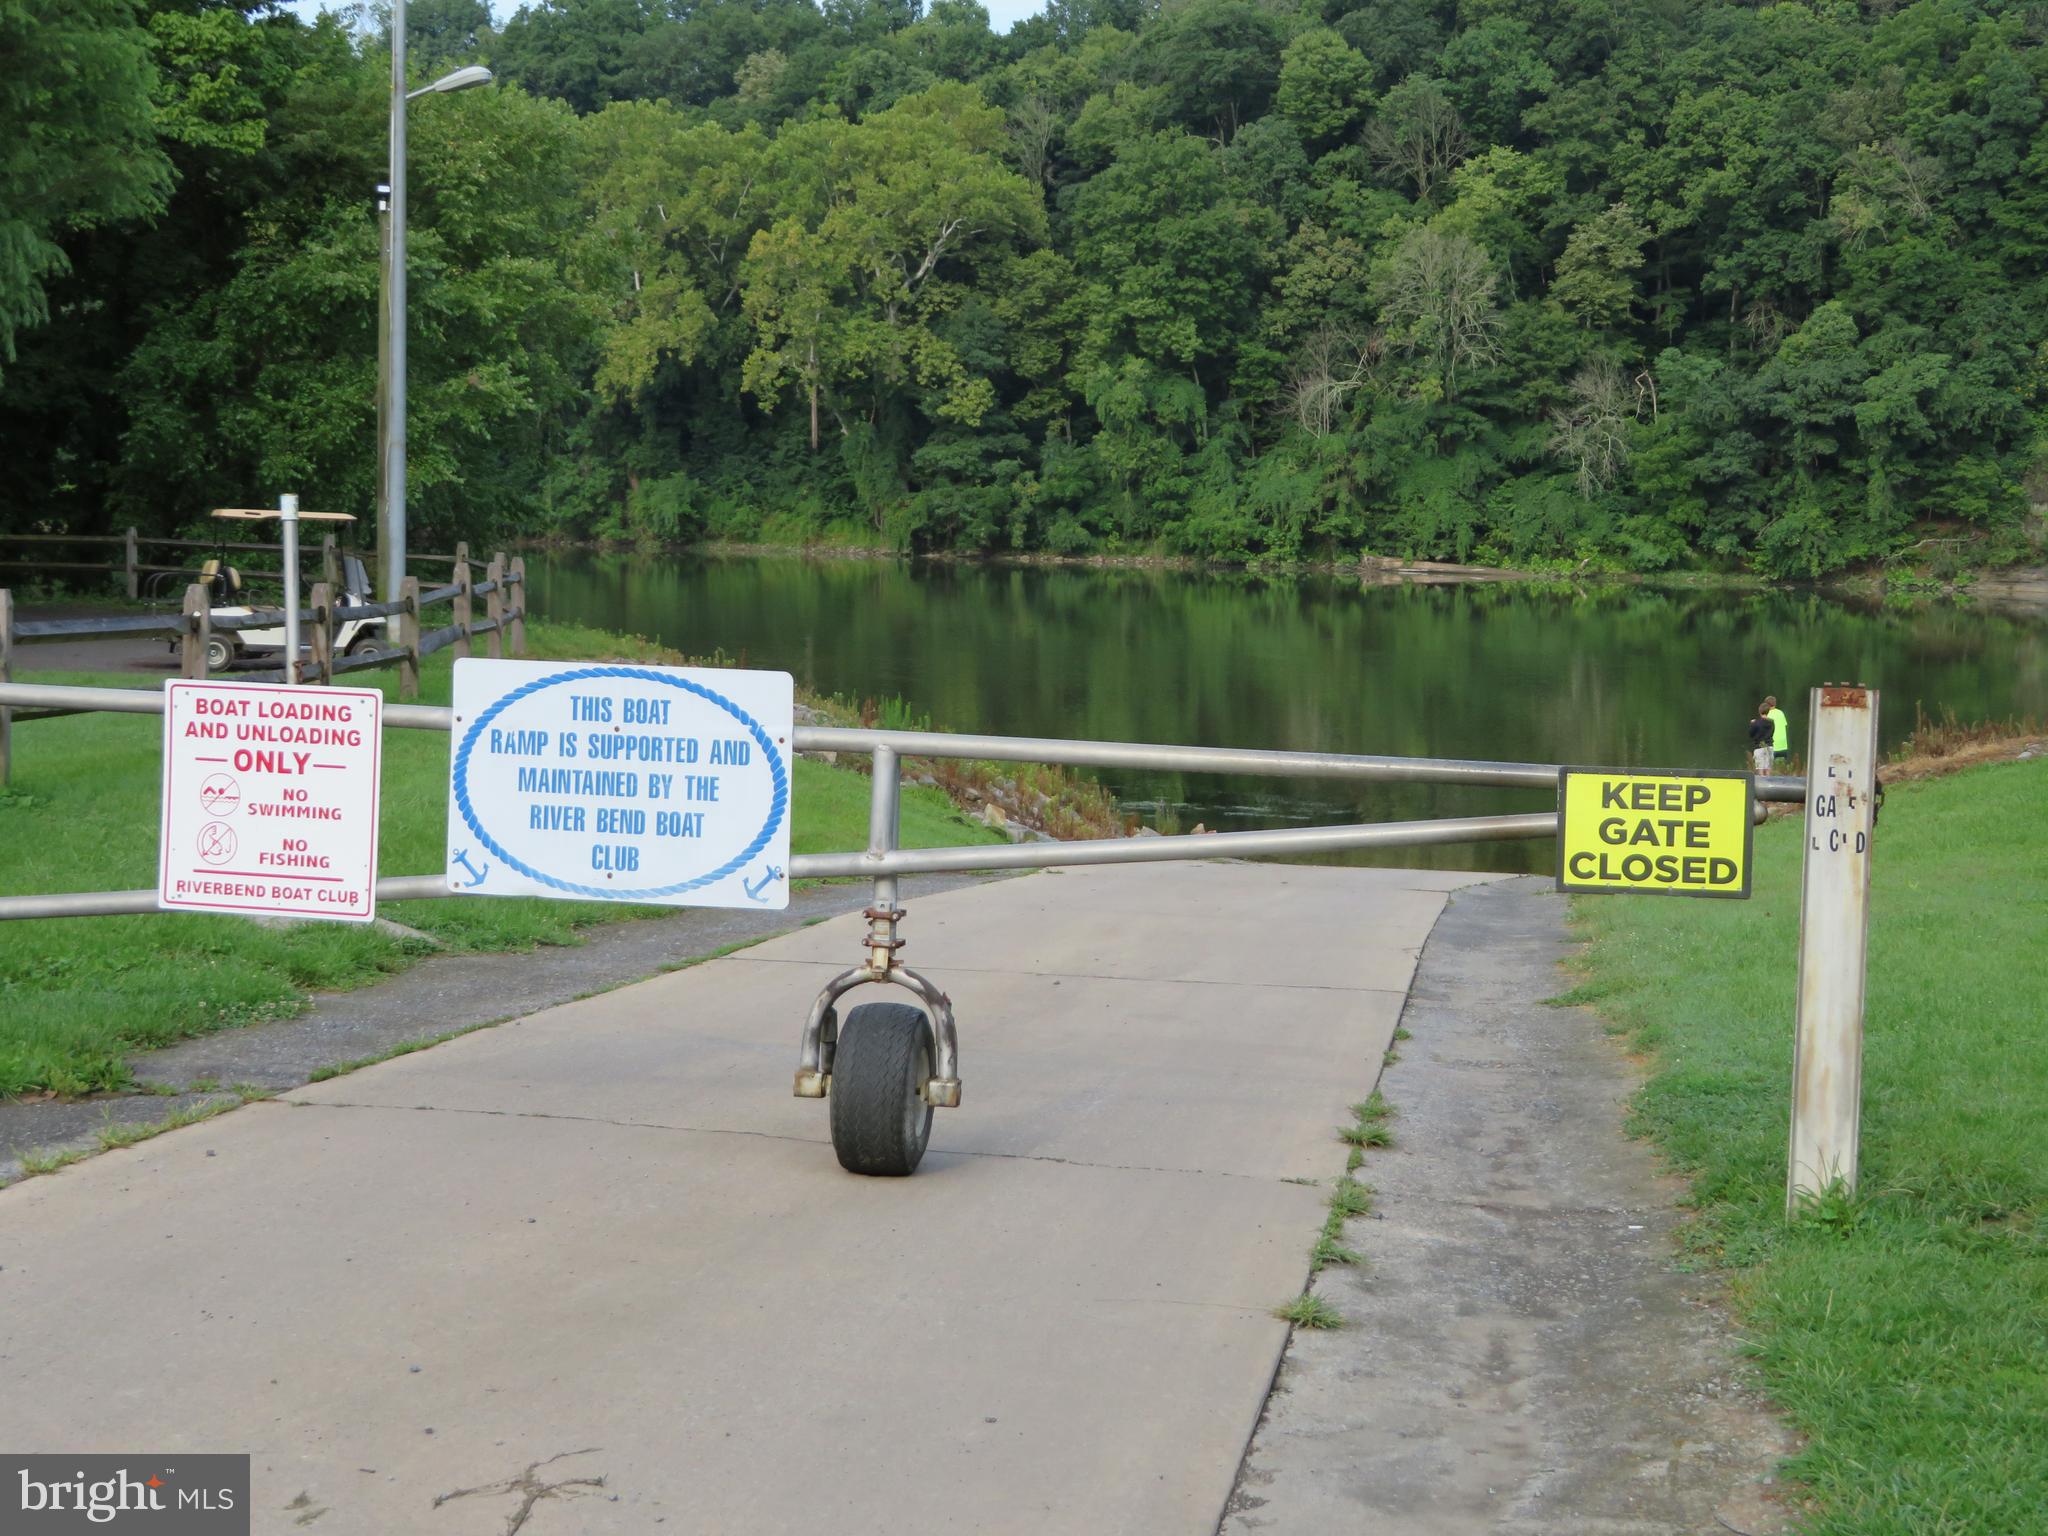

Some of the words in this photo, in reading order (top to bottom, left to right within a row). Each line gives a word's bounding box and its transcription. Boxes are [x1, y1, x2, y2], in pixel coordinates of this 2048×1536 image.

[196, 698, 250, 716] BOAT
[258, 702, 352, 722] LOADING
[571, 695, 613, 723] THIS
[623, 698, 671, 725] BOAT
[185, 721, 228, 739] AND
[237, 725, 361, 747] UNLOADING
[490, 729, 549, 756] RAMP
[560, 732, 578, 758] IS
[588, 733, 698, 764] SUPPORTED
[709, 740, 751, 767] AND
[234, 749, 311, 775] ONLY
[283, 788, 308, 802] NO
[518, 768, 638, 798] MAINTAINED
[649, 773, 673, 800] BY
[687, 775, 719, 802] THE
[1602, 782, 1711, 812] KEEP
[248, 803, 342, 820] SWIMMING
[530, 804, 586, 832] RIVER
[596, 808, 646, 836] BEND
[656, 811, 705, 838] BOAT
[282, 839, 308, 852] NO
[1599, 817, 1710, 849] GATE
[259, 852, 330, 868] FISHING
[592, 844, 640, 872] CLUB
[1569, 851, 1738, 885] CLOSED
[176, 880, 266, 898] RIVERBEND
[271, 886, 312, 901] BOAT
[318, 889, 359, 904] CLUB
